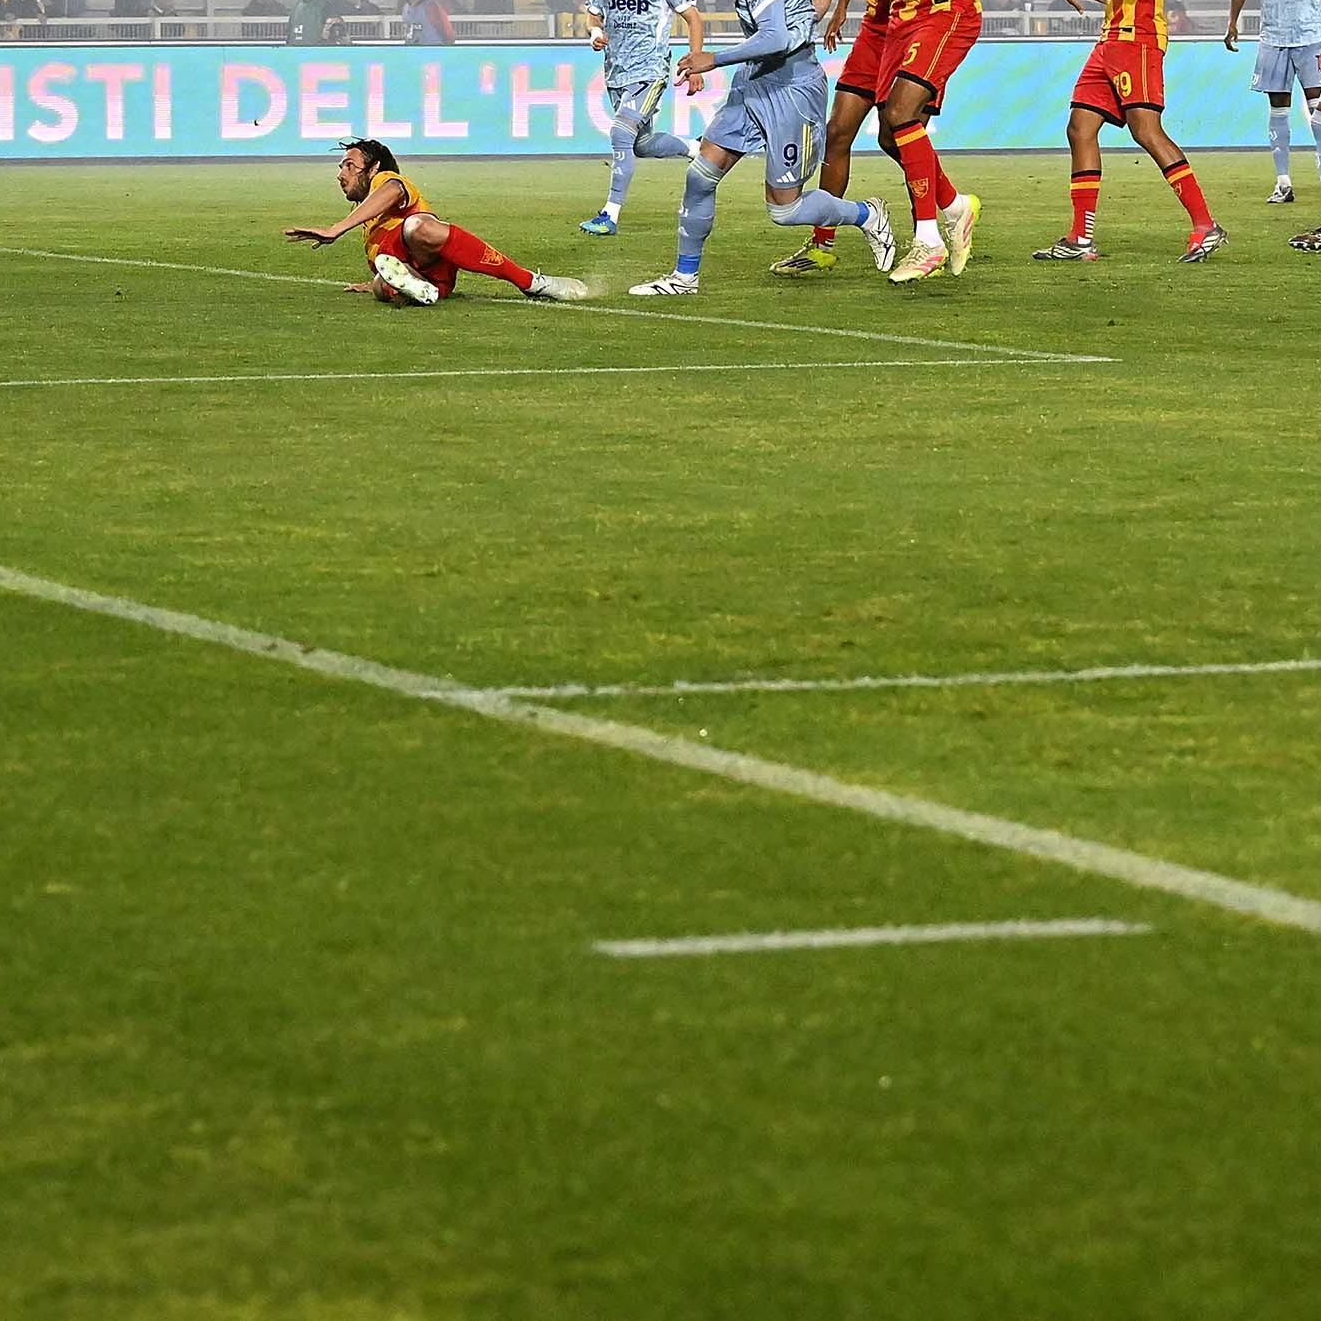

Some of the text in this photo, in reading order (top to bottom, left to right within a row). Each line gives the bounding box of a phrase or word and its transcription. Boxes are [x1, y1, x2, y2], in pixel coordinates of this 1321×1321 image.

[903, 42, 921, 66] 5
[632, 80, 651, 98] 7
[1112, 70, 1133, 98] 9
[783, 143, 799, 167] 9
